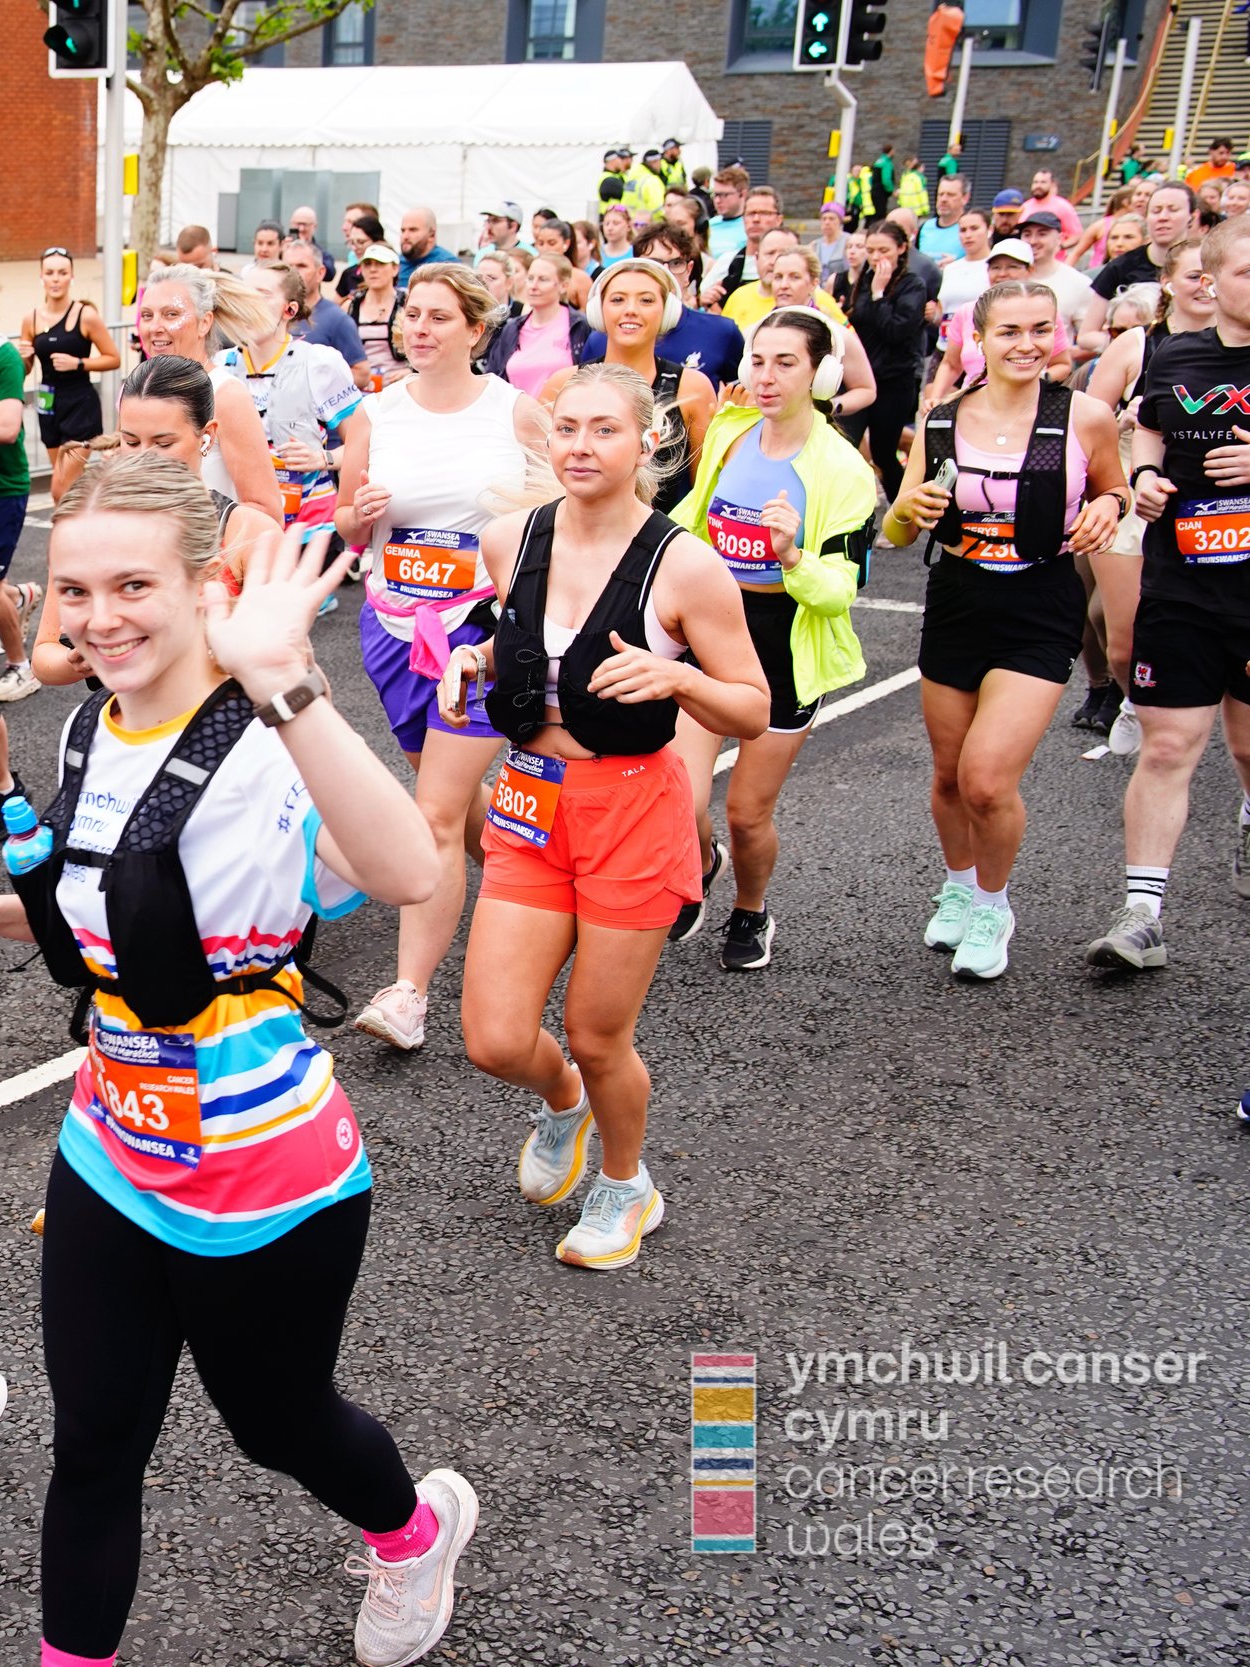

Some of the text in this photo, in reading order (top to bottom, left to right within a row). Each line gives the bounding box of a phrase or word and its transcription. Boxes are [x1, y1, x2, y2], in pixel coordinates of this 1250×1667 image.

[1171, 430, 1239, 440] YSTALYFE
[427, 530, 460, 541] SWANSEA
[1177, 521, 1203, 531] CIAN
[716, 531, 766, 559] 8098
[1194, 528, 1250, 551] 3202
[385, 545, 421, 559] GEMMA
[398, 559, 456, 585] 6647
[621, 765, 646, 777] TALA
[496, 782, 538, 823] 5802
[101, 1031, 159, 1050] SWANSEA
[97, 1071, 170, 1131] 1843
